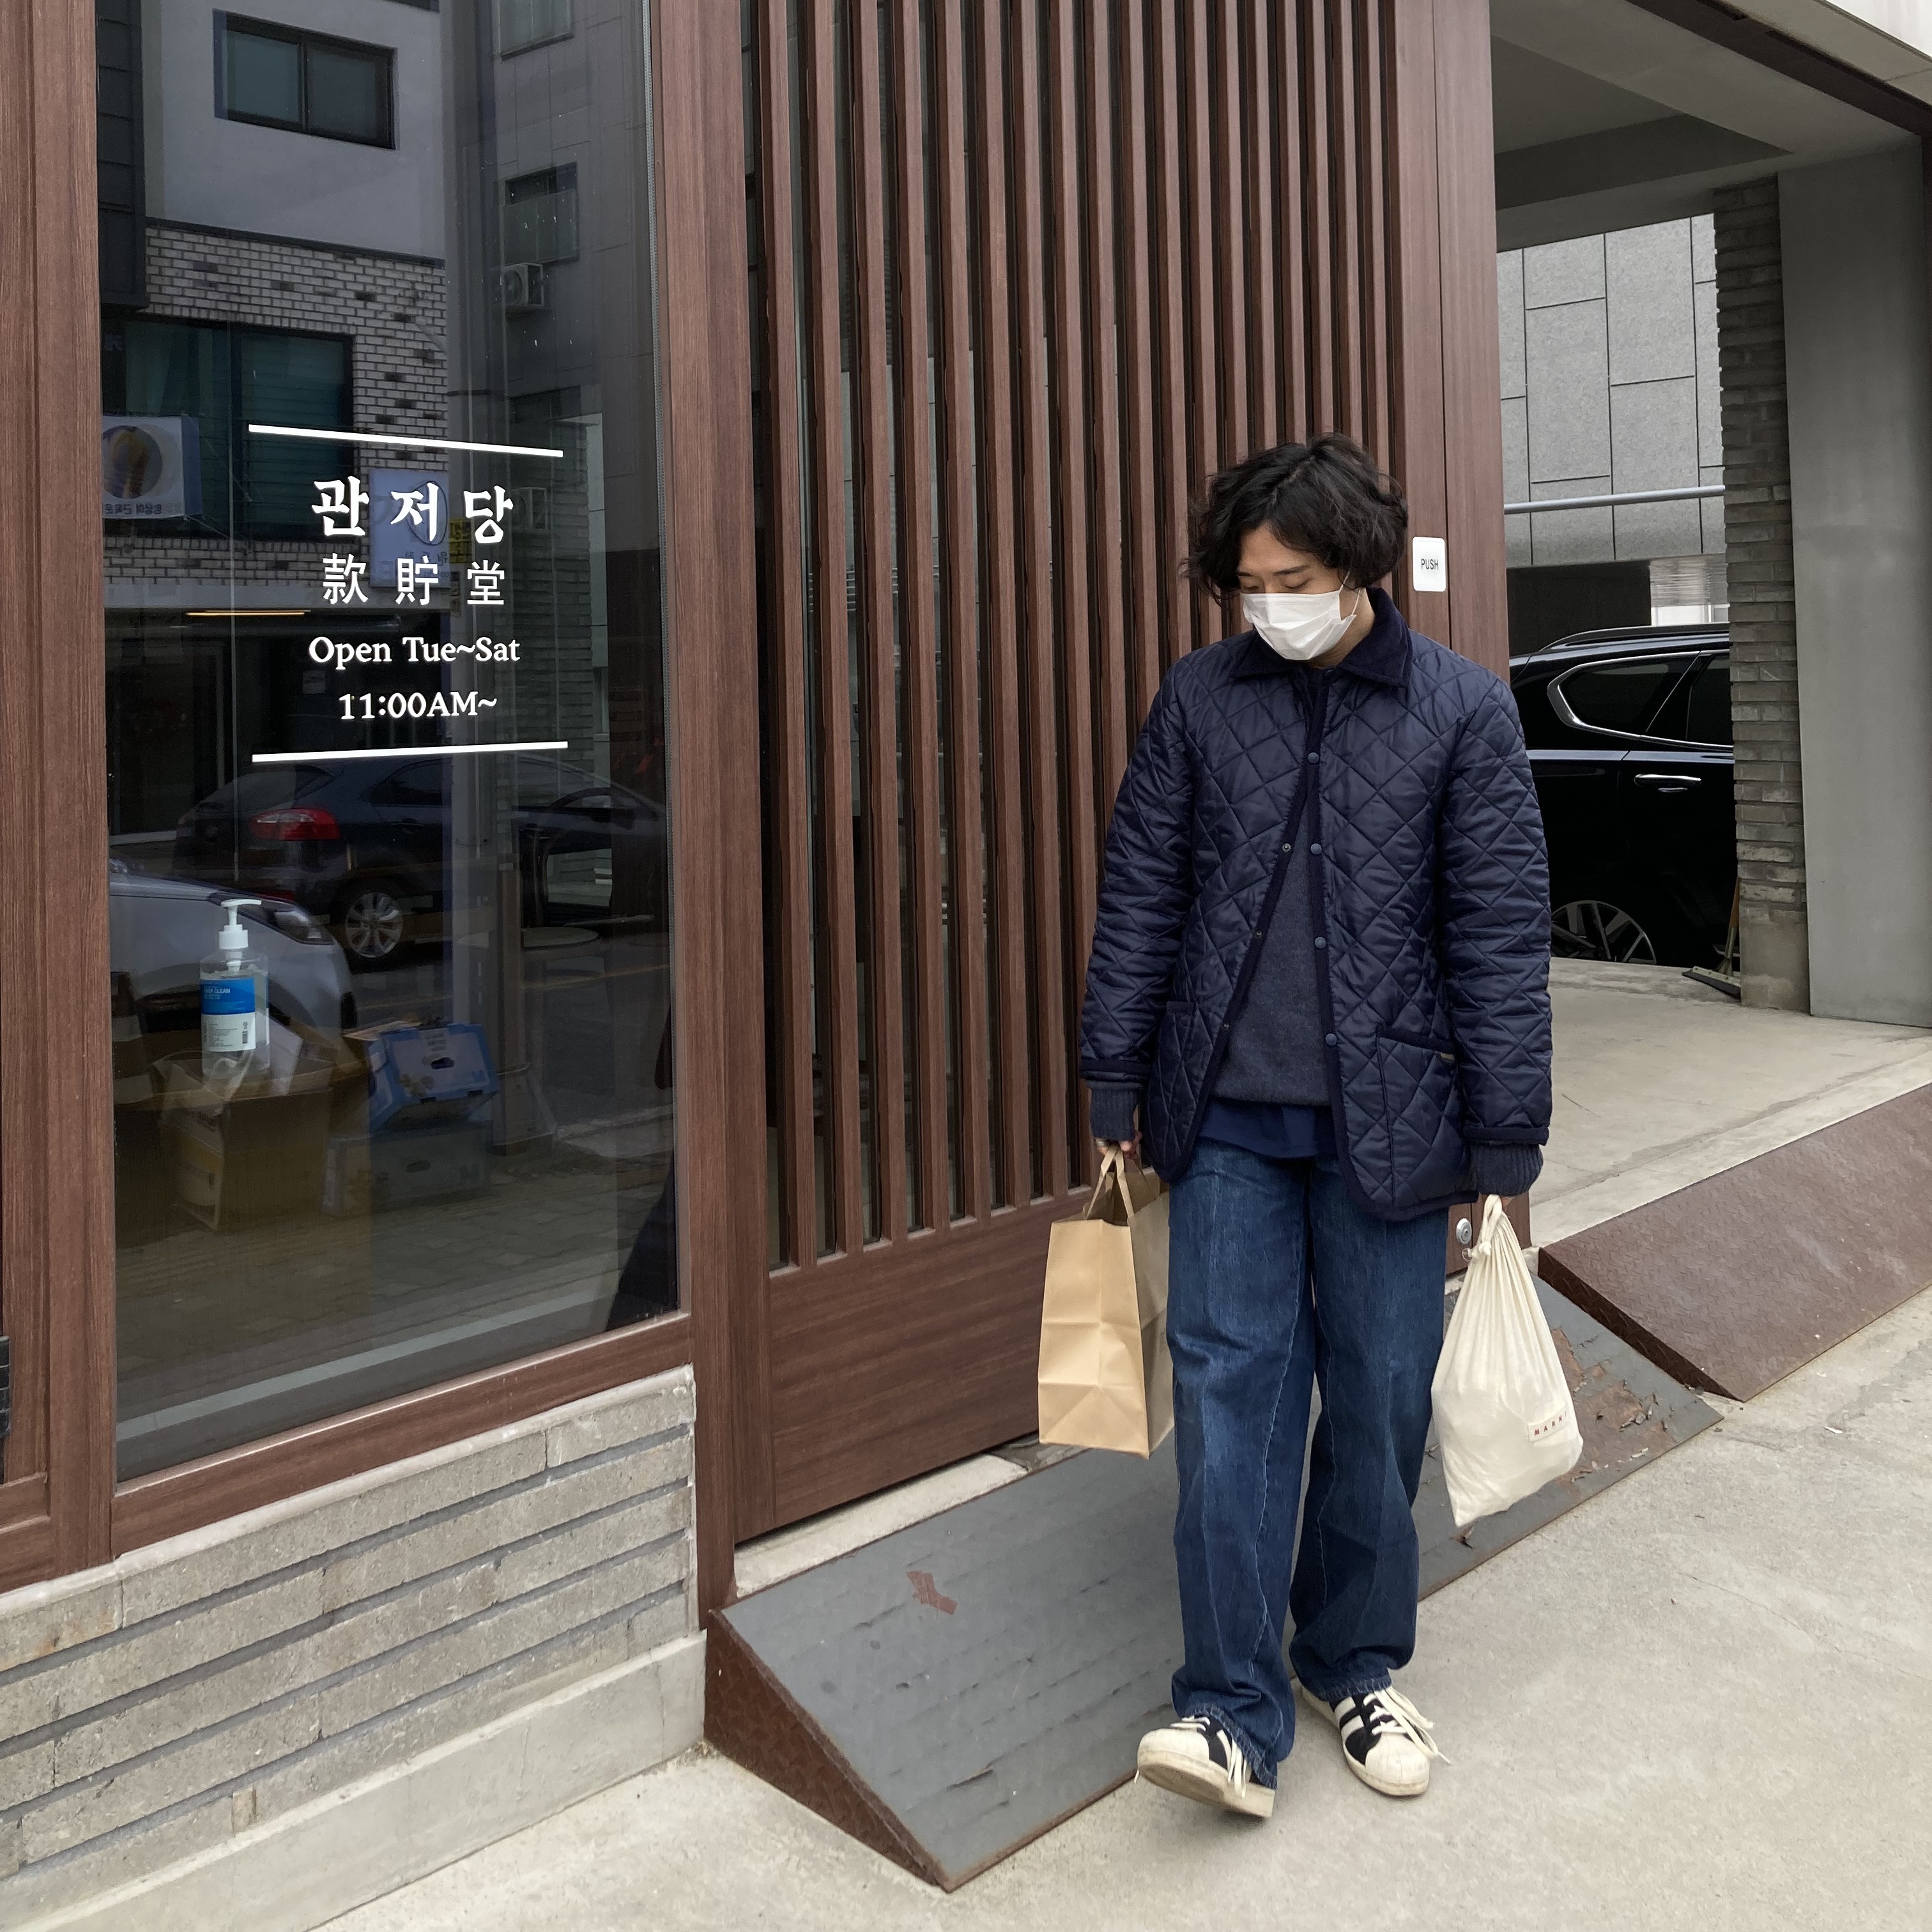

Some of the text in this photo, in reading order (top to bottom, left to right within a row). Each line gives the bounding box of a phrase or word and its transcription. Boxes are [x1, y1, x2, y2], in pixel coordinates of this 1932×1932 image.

[312, 476, 514, 544] 관저당
[1421, 558, 1439, 571] PUSH
[309, 636, 521, 670] Open Tue~Sat
[339, 691, 498, 720] 11:00AM~
